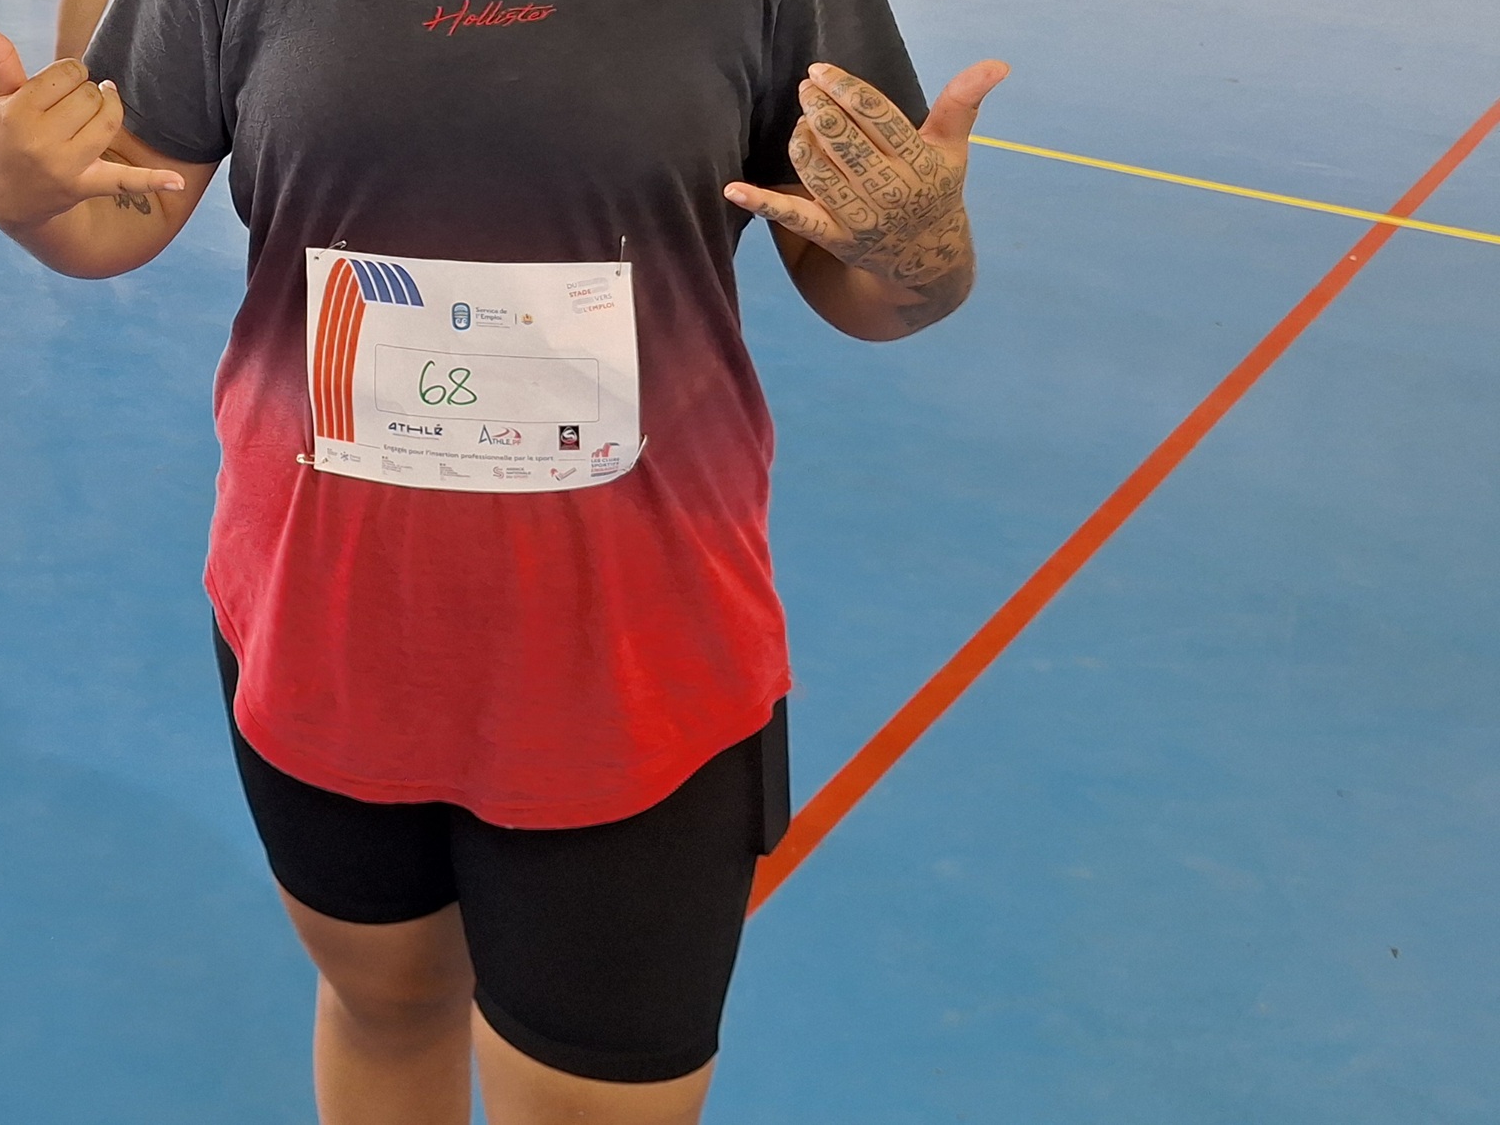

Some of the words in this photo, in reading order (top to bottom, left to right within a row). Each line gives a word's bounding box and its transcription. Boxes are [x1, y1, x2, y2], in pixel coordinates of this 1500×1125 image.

[569, 289, 592, 298] STADE
[594, 293, 612, 301] VERS
[475, 306, 499, 314] Service
[419, 360, 478, 406] 68
[425, 449, 459, 458] l'insertion
[460, 452, 512, 463] professionnelle
